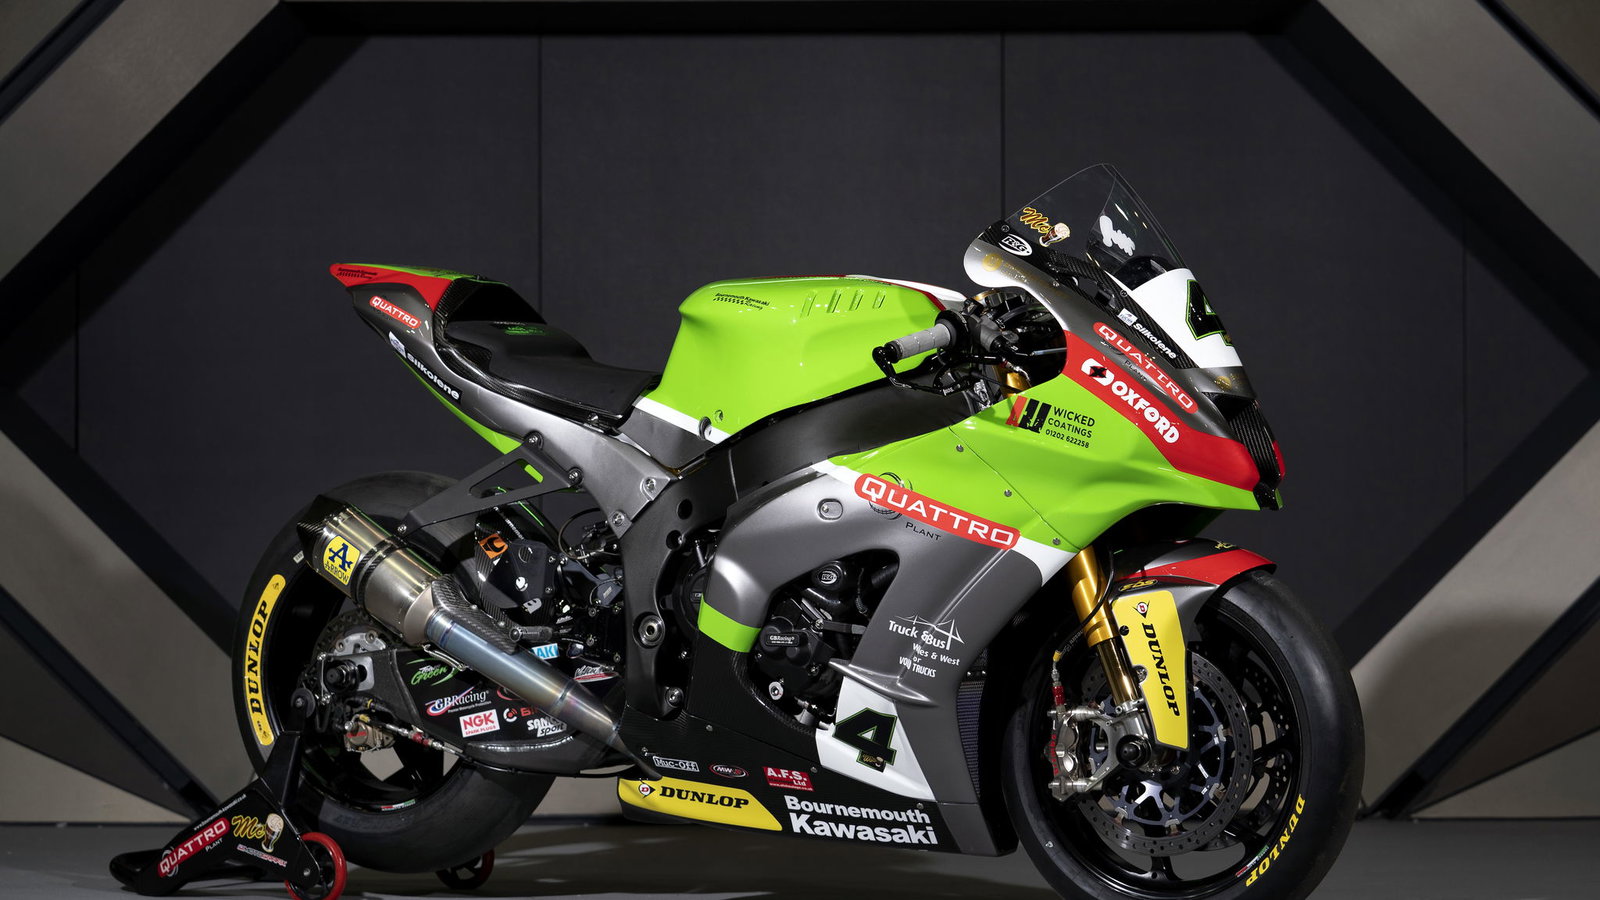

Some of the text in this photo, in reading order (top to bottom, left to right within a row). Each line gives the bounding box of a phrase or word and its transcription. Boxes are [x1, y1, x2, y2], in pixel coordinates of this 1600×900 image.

[372, 297, 419, 327] QUATTRO
[1132, 322, 1179, 360] Silkolene
[407, 352, 460, 400] Silkolene
[1098, 324, 1194, 409] QUATTRO
[1053, 406, 1096, 428] WICKED
[1111, 380, 1180, 444] OXFORD
[1045, 428, 1090, 449] 01202 622258
[1047, 417, 1093, 439] COATINGS
[861, 476, 1015, 546] QUATTRO
[905, 521, 942, 541] PLANT
[324, 560, 350, 583] ARROW
[888, 619, 919, 639] Truck
[247, 600, 269, 715] DUNLOP
[930, 652, 938, 660] &
[939, 654, 961, 667] West
[411, 665, 449, 686] Green
[912, 662, 937, 678] TRUCKS
[1141, 622, 1181, 717] DUNLOP
[434, 690, 488, 710] GBRacing
[462, 712, 495, 730] NGK
[465, 724, 496, 735] SPARK PLUGS
[832, 707, 898, 773] 4
[654, 757, 697, 771] Muc-Off
[767, 767, 808, 781] A.F.S.
[659, 786, 750, 809] DUNLOP
[784, 795, 931, 824] Bournemouth
[789, 812, 939, 845] Kawasaki
[158, 820, 227, 875] QUATTRO
[204, 837, 224, 852] PLANT
[1245, 793, 1306, 888] DUNLOP
